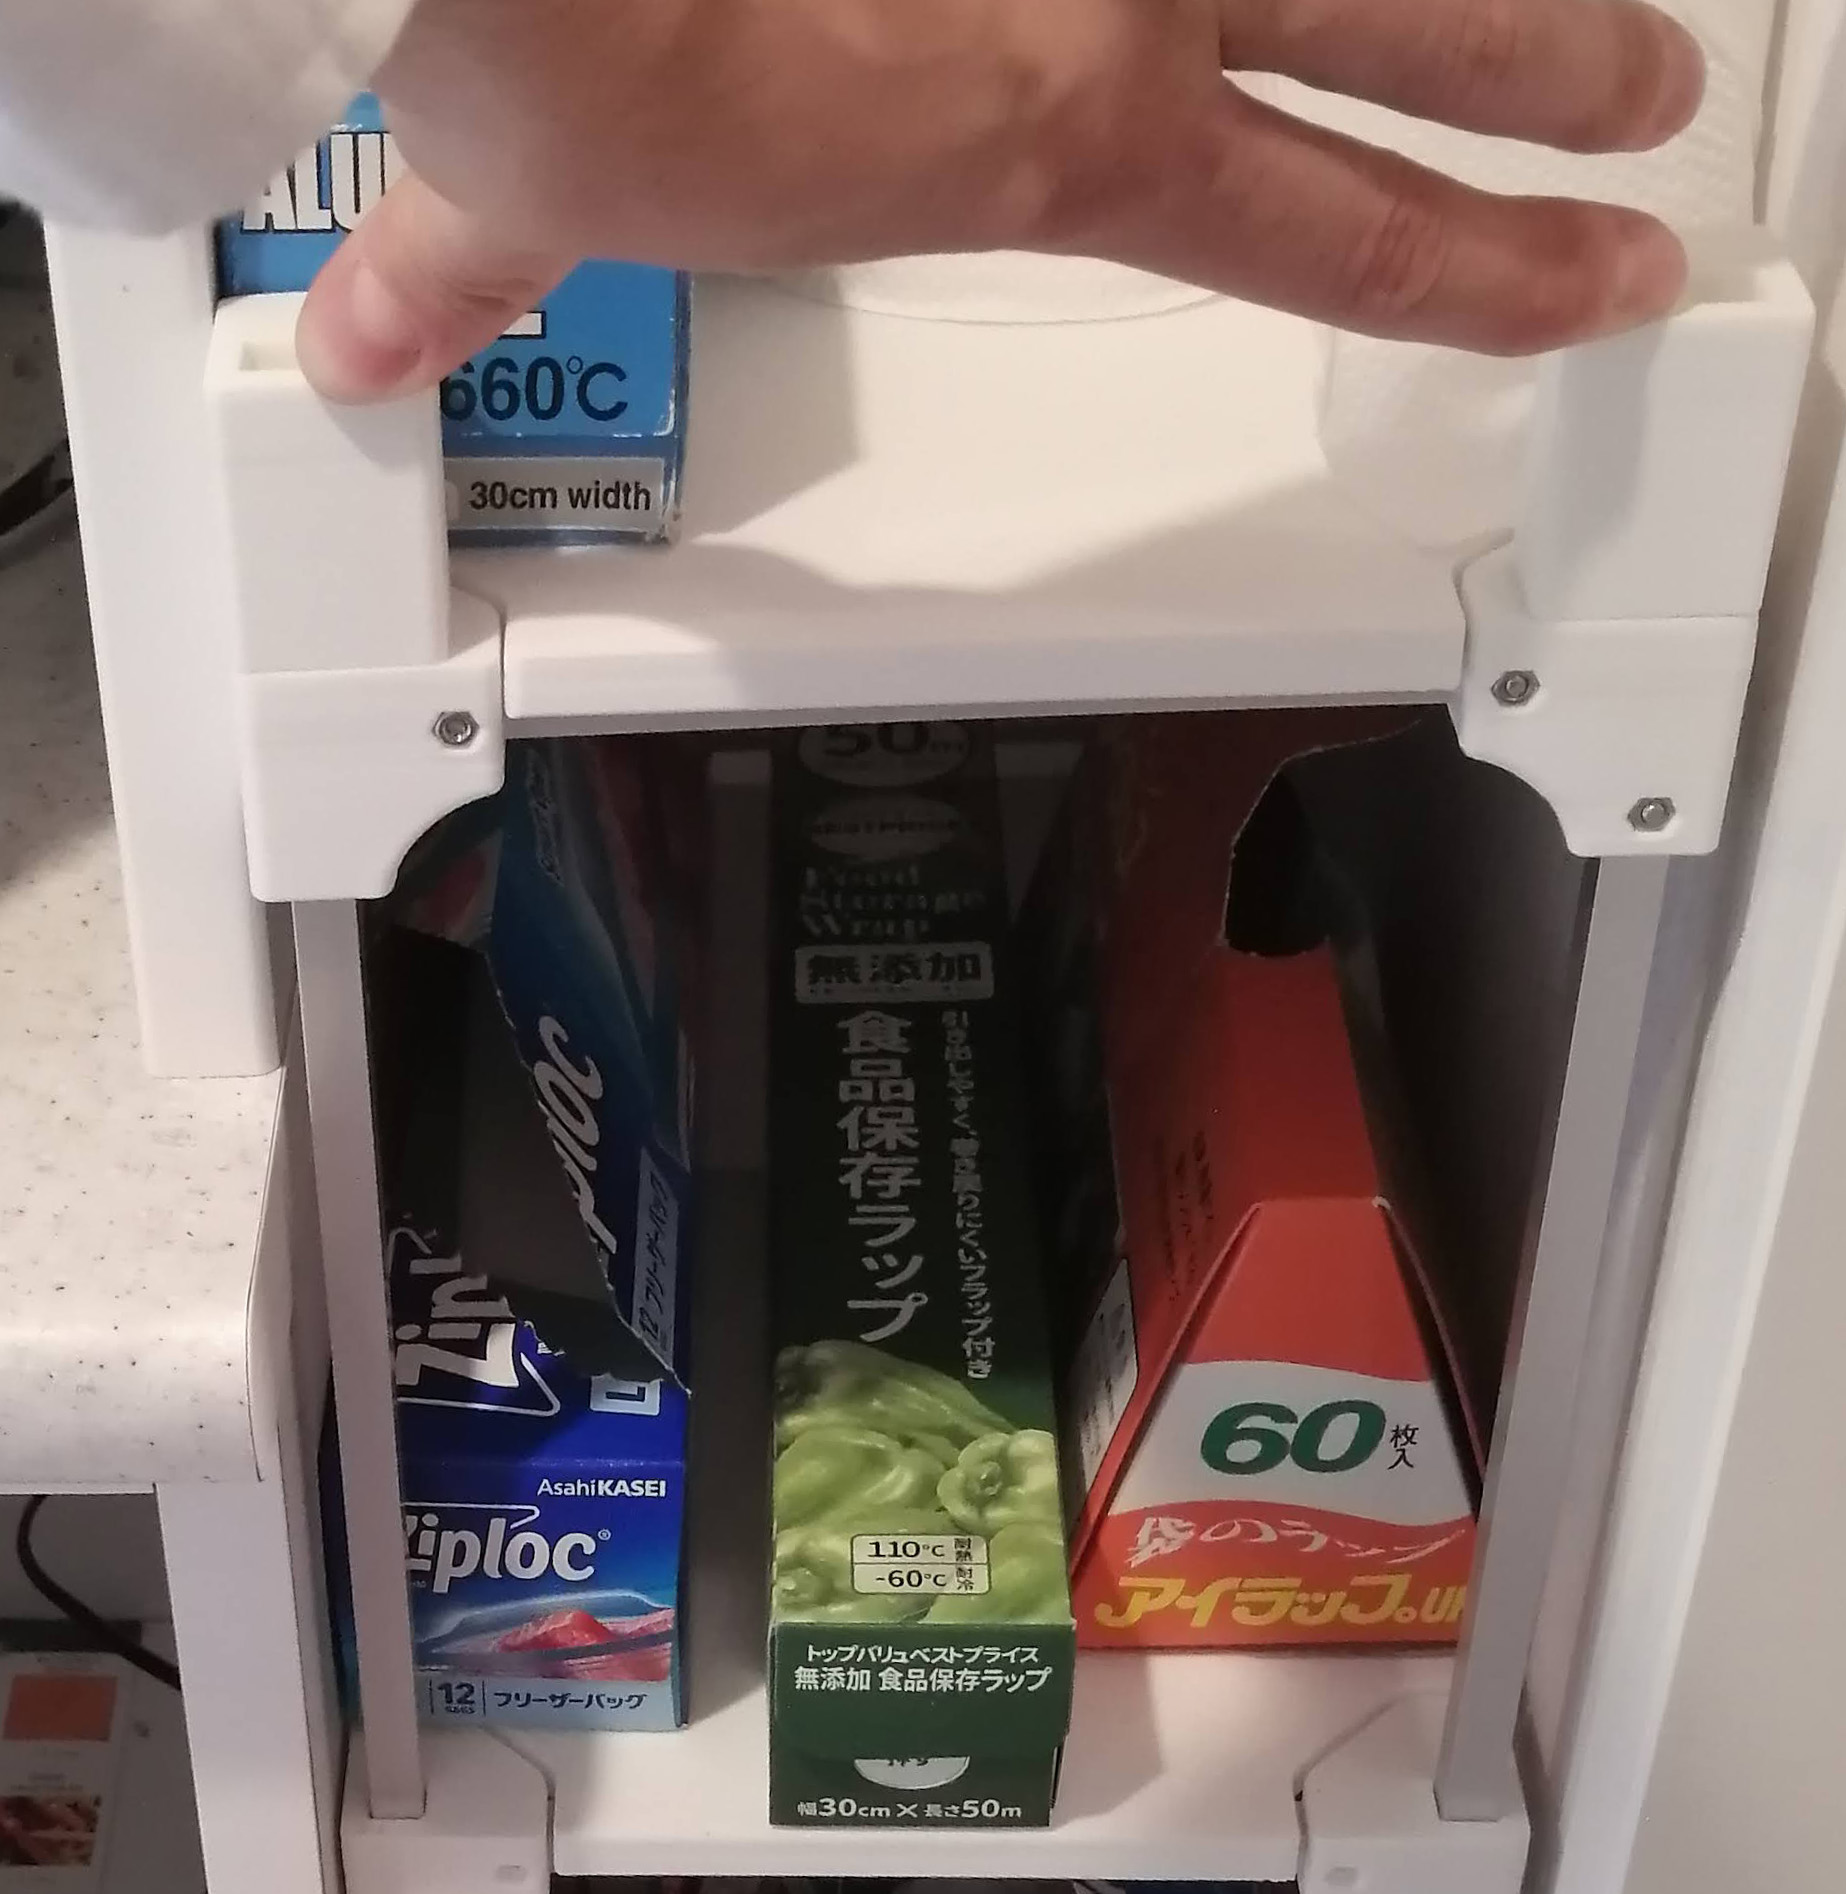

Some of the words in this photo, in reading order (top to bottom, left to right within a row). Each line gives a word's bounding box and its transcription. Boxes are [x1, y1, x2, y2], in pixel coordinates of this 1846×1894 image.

[470, 481, 558, 510] 30cm
[568, 480, 651, 511] width
[835, 1010, 928, 1343] 食品保存ラップ
[1200, 1399, 1386, 1475] 60
[1387, 1424, 1420, 1470] 枚入
[807, 1645, 1039, 1664] トップバリュベストプライス
[438, 1682, 475, 1704] 12
[795, 1667, 871, 1691] 無添加
[879, 1667, 1052, 1693] 食品保存ラップ
[494, 1692, 648, 1710] フリーザーバッグ
